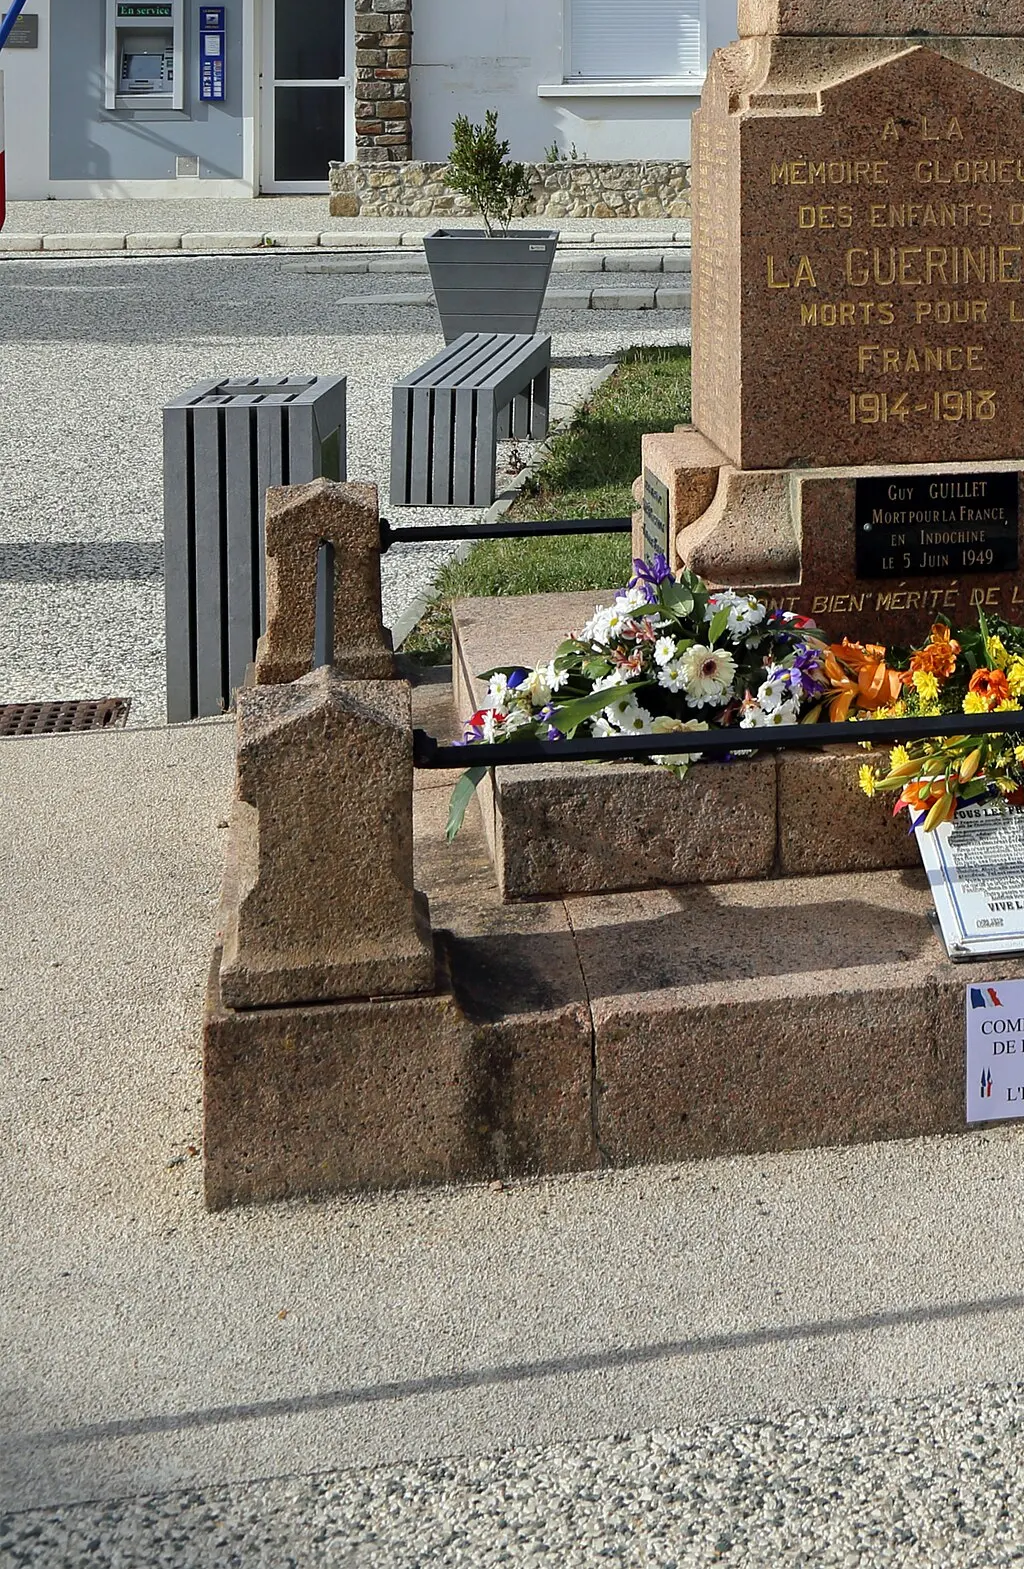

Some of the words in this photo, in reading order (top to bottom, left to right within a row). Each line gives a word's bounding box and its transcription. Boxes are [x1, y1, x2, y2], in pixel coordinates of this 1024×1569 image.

[120, 6, 134, 15] En
[137, 6, 170, 15] service
[922, 117, 963, 140] LA
[800, 205, 852, 228] DES
[870, 203, 992, 228] ENFANTS
[767, 254, 816, 289] LA
[800, 301, 895, 326] MORTS
[915, 299, 988, 325] POUR
[850, 389, 997, 424] 1914-1918
[929, 481, 988, 499] GUILLET
[891, 534, 906, 547] EN
[882, 557, 895, 570] LE
[903, 552, 911, 569] 5
[962, 548, 994, 566] 1949
[875, 580, 960, 613] MÉRITÉ
[969, 587, 1001, 606] DE
[988, 902, 1013, 912] VIVE
[993, 1040, 1016, 1055] DE
